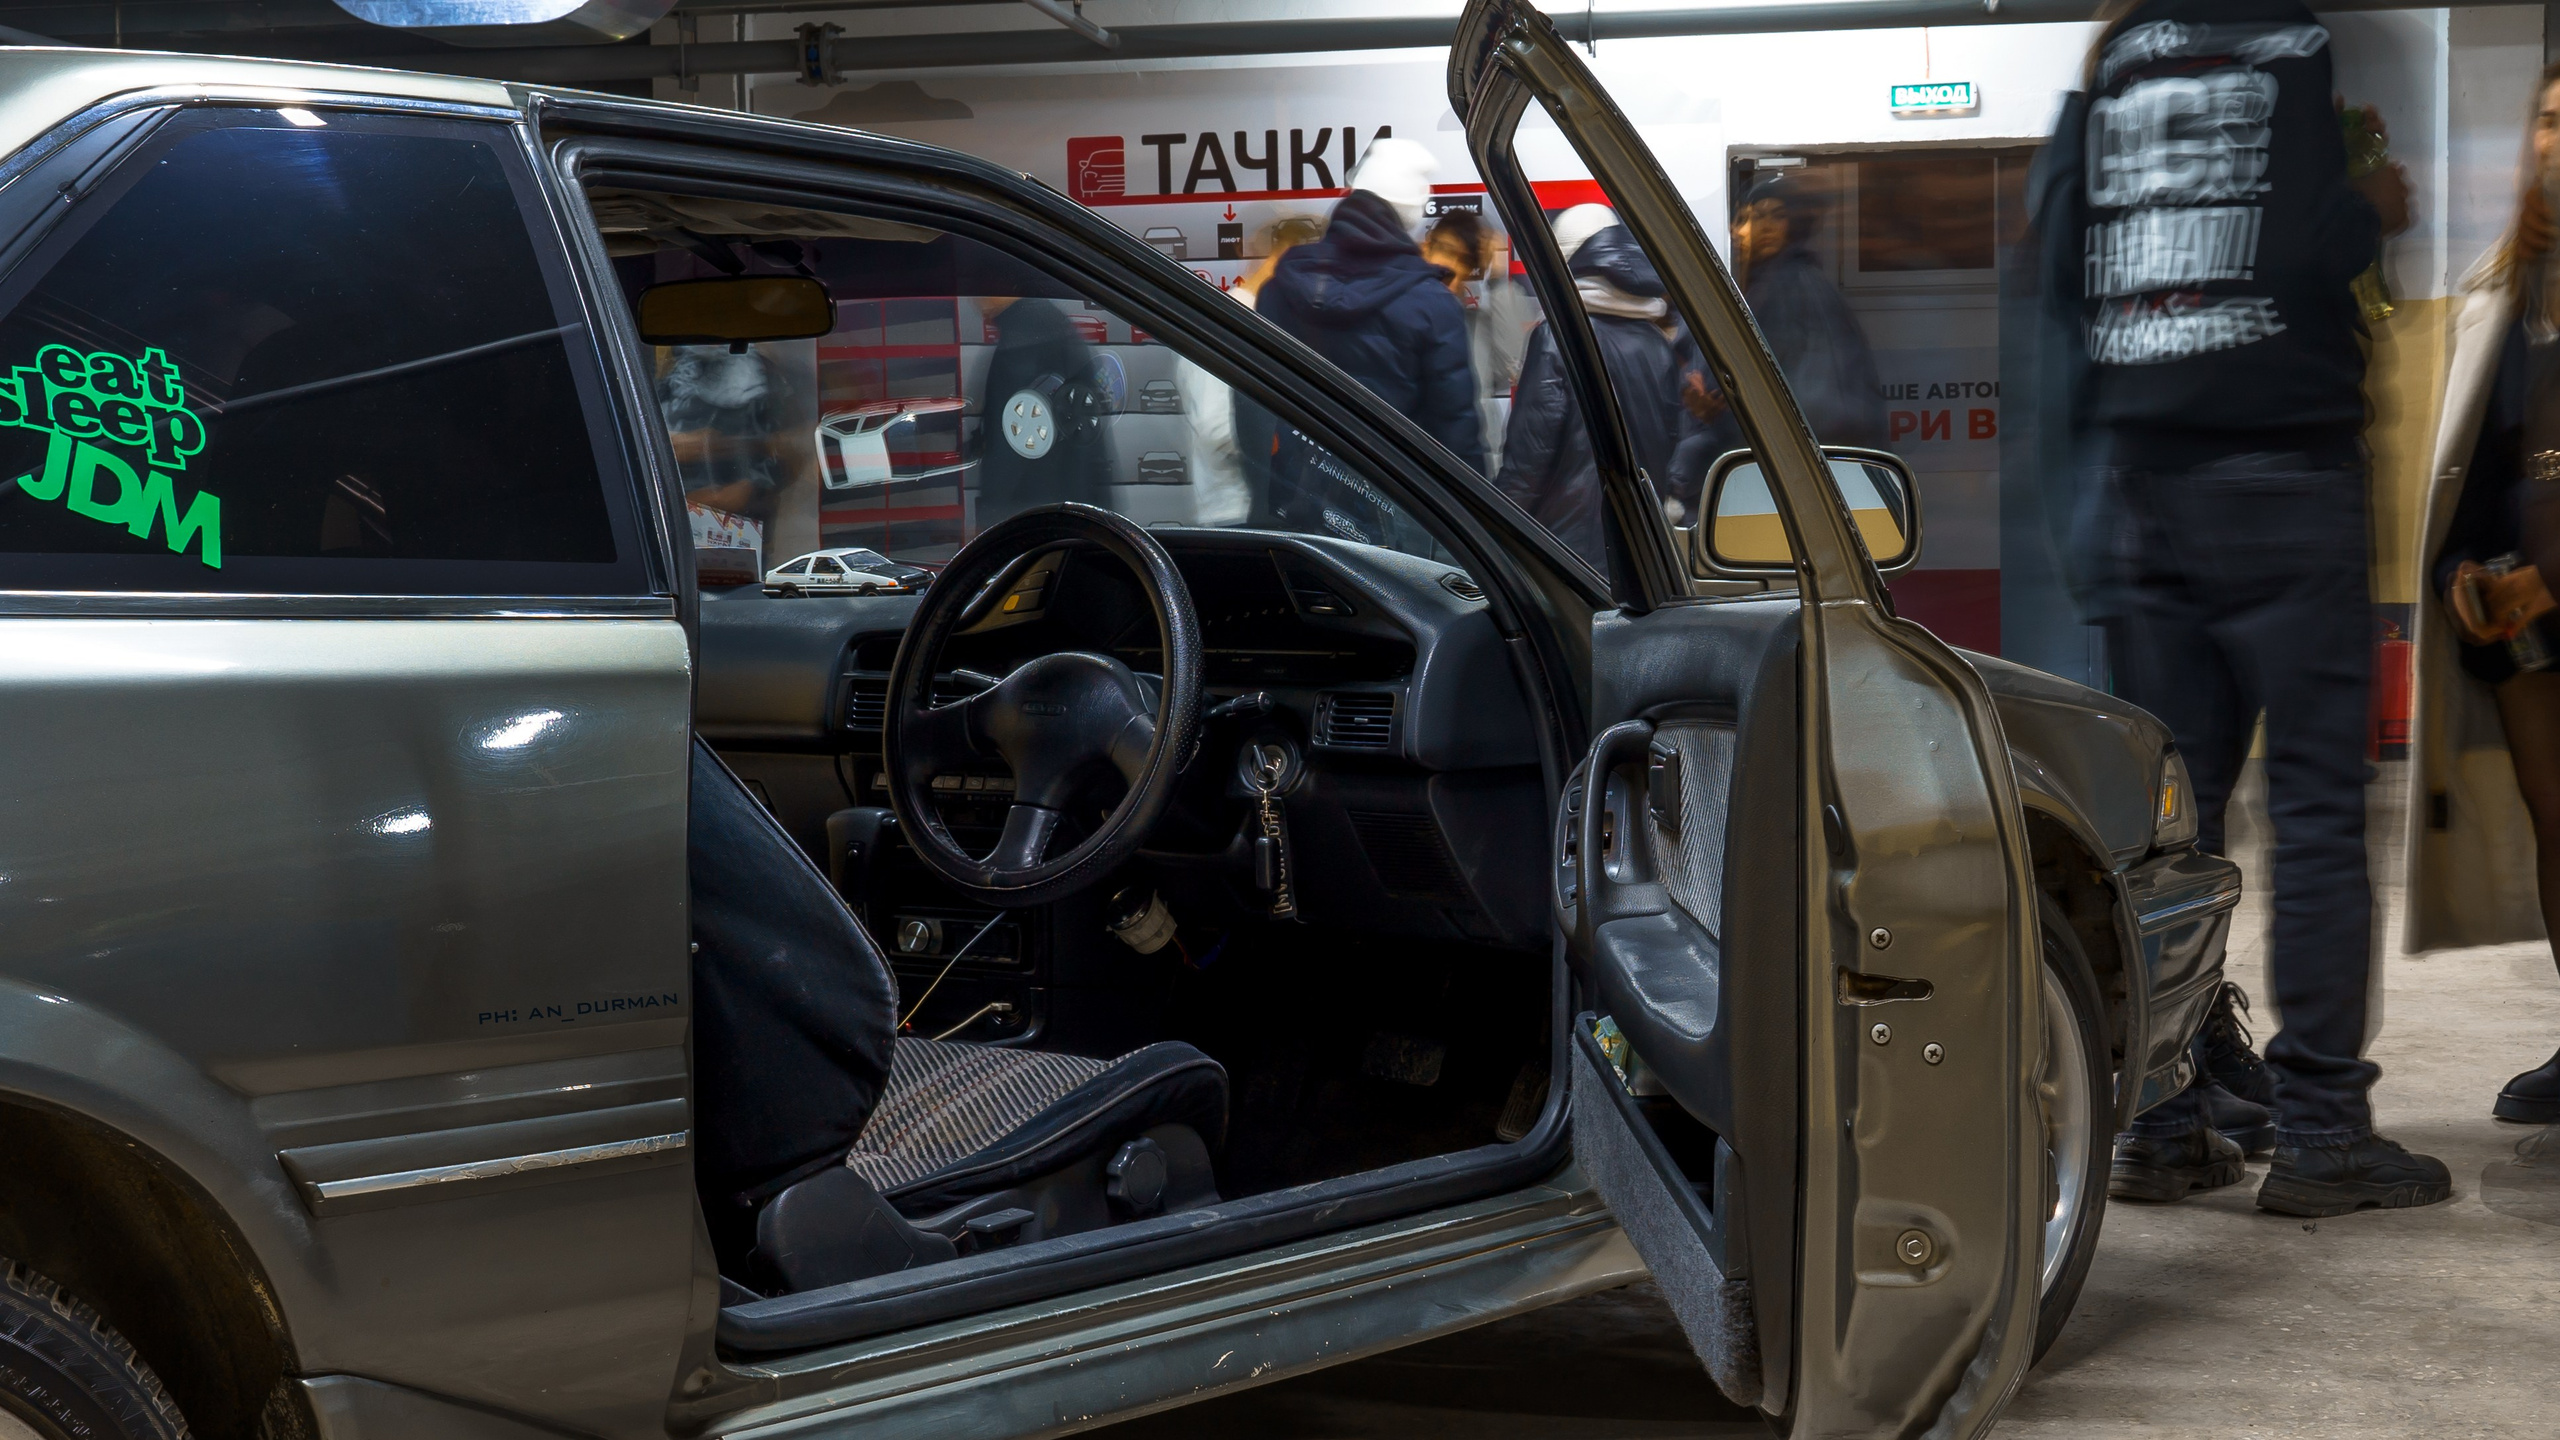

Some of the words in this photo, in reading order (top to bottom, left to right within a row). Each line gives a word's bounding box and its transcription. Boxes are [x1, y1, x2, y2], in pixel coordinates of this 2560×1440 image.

[1895, 84, 1969, 105] ВЫХОД
[1425, 201, 1437, 215] 6
[36, 343, 184, 407] eat
[1926, 381, 1999, 400] АВТО
[17, 430, 221, 569] JDM
